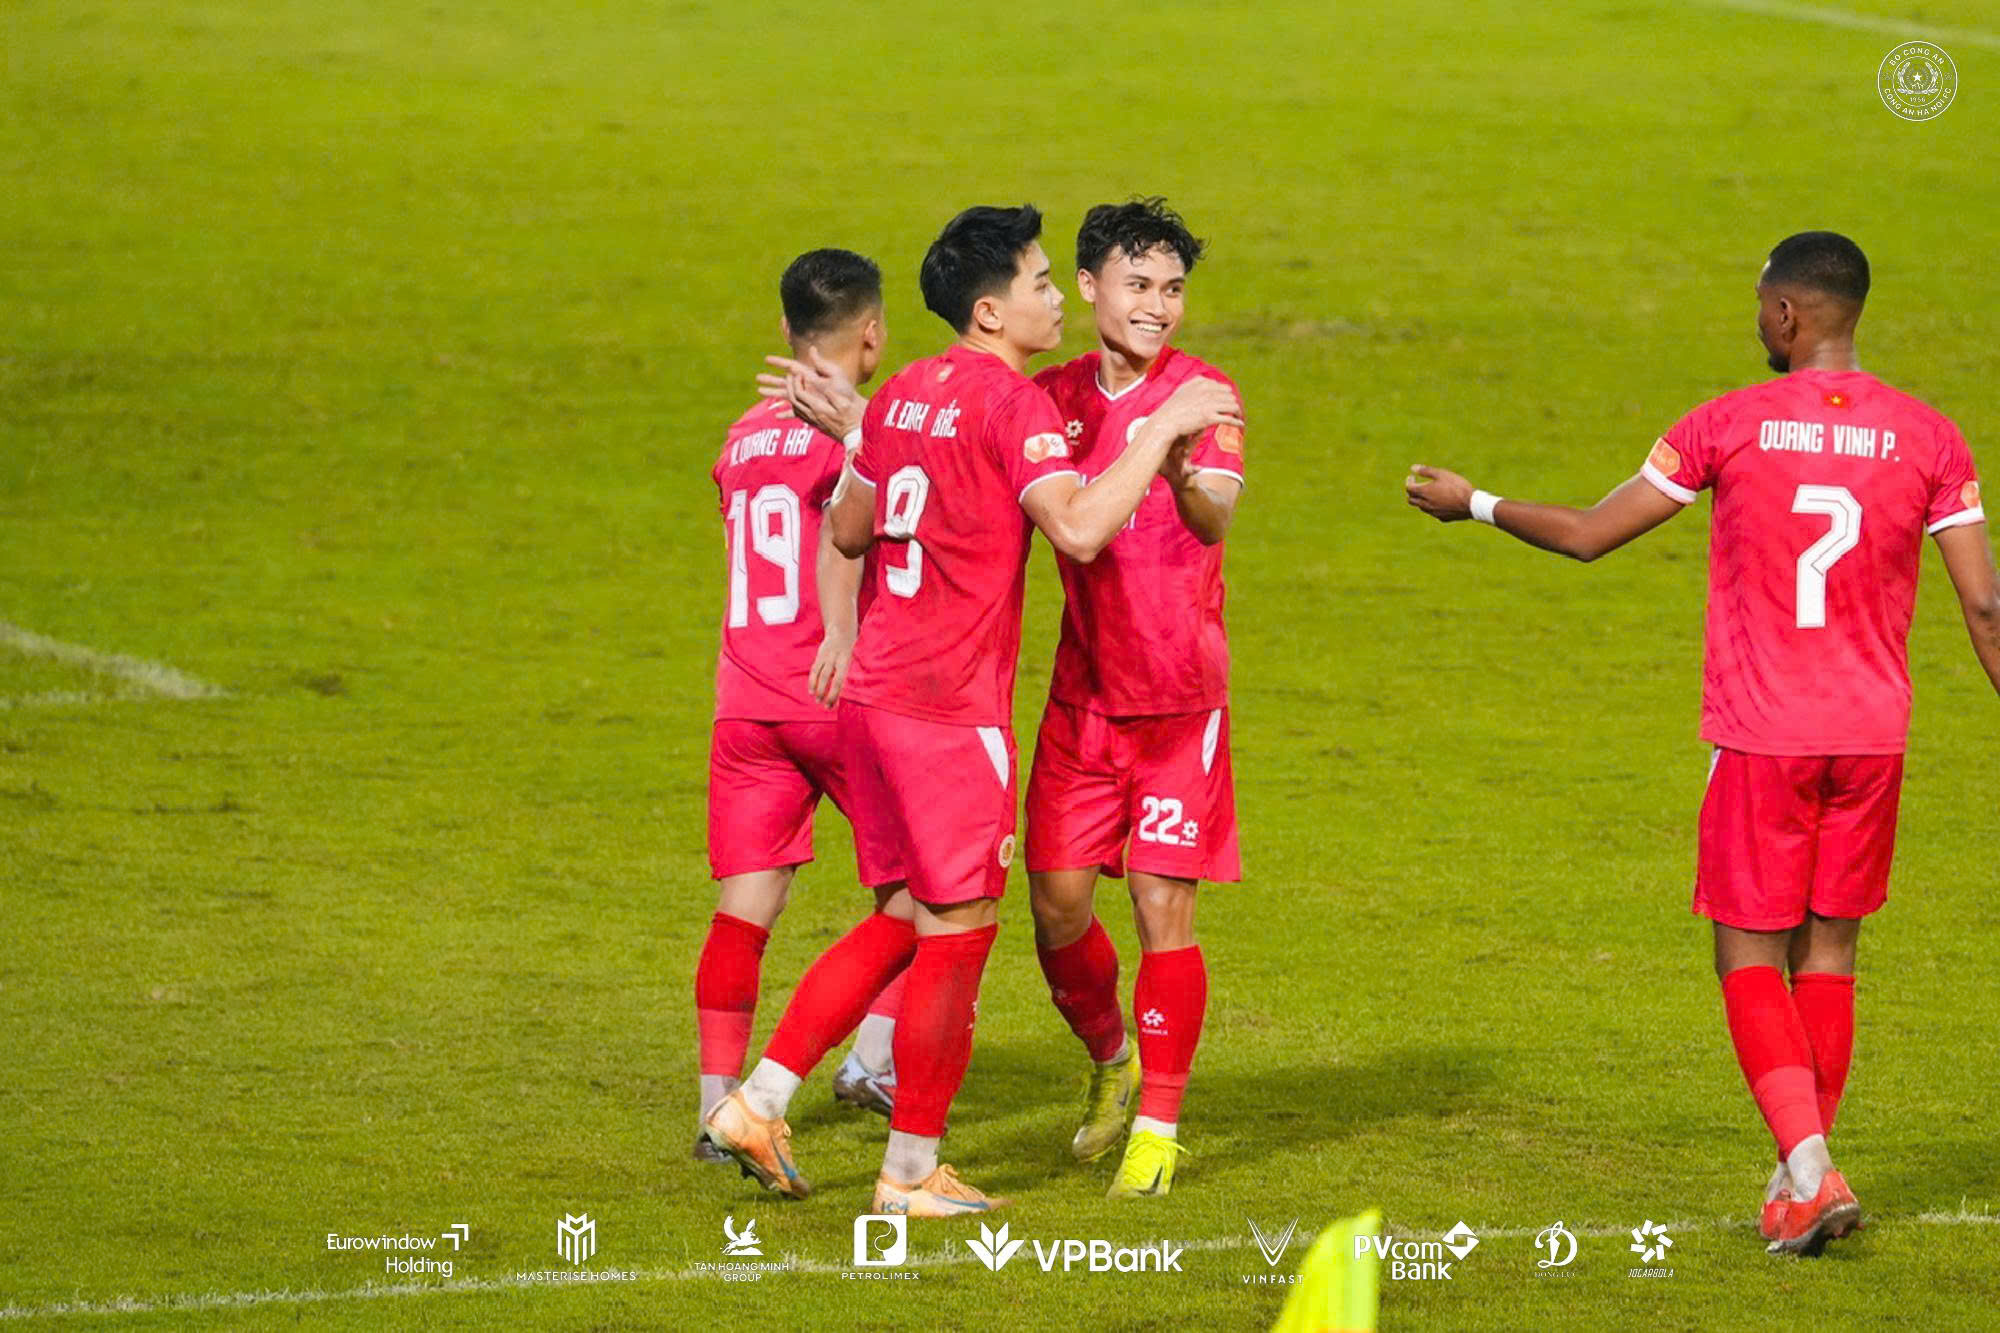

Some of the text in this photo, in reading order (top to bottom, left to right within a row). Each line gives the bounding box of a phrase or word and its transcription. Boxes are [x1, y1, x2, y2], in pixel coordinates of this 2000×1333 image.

[1759, 419, 1901, 462] QUANG VINH P.
[727, 483, 801, 629] 19
[883, 465, 930, 599] 9
[1791, 483, 1864, 629] 7
[1138, 796, 1183, 845] 22
